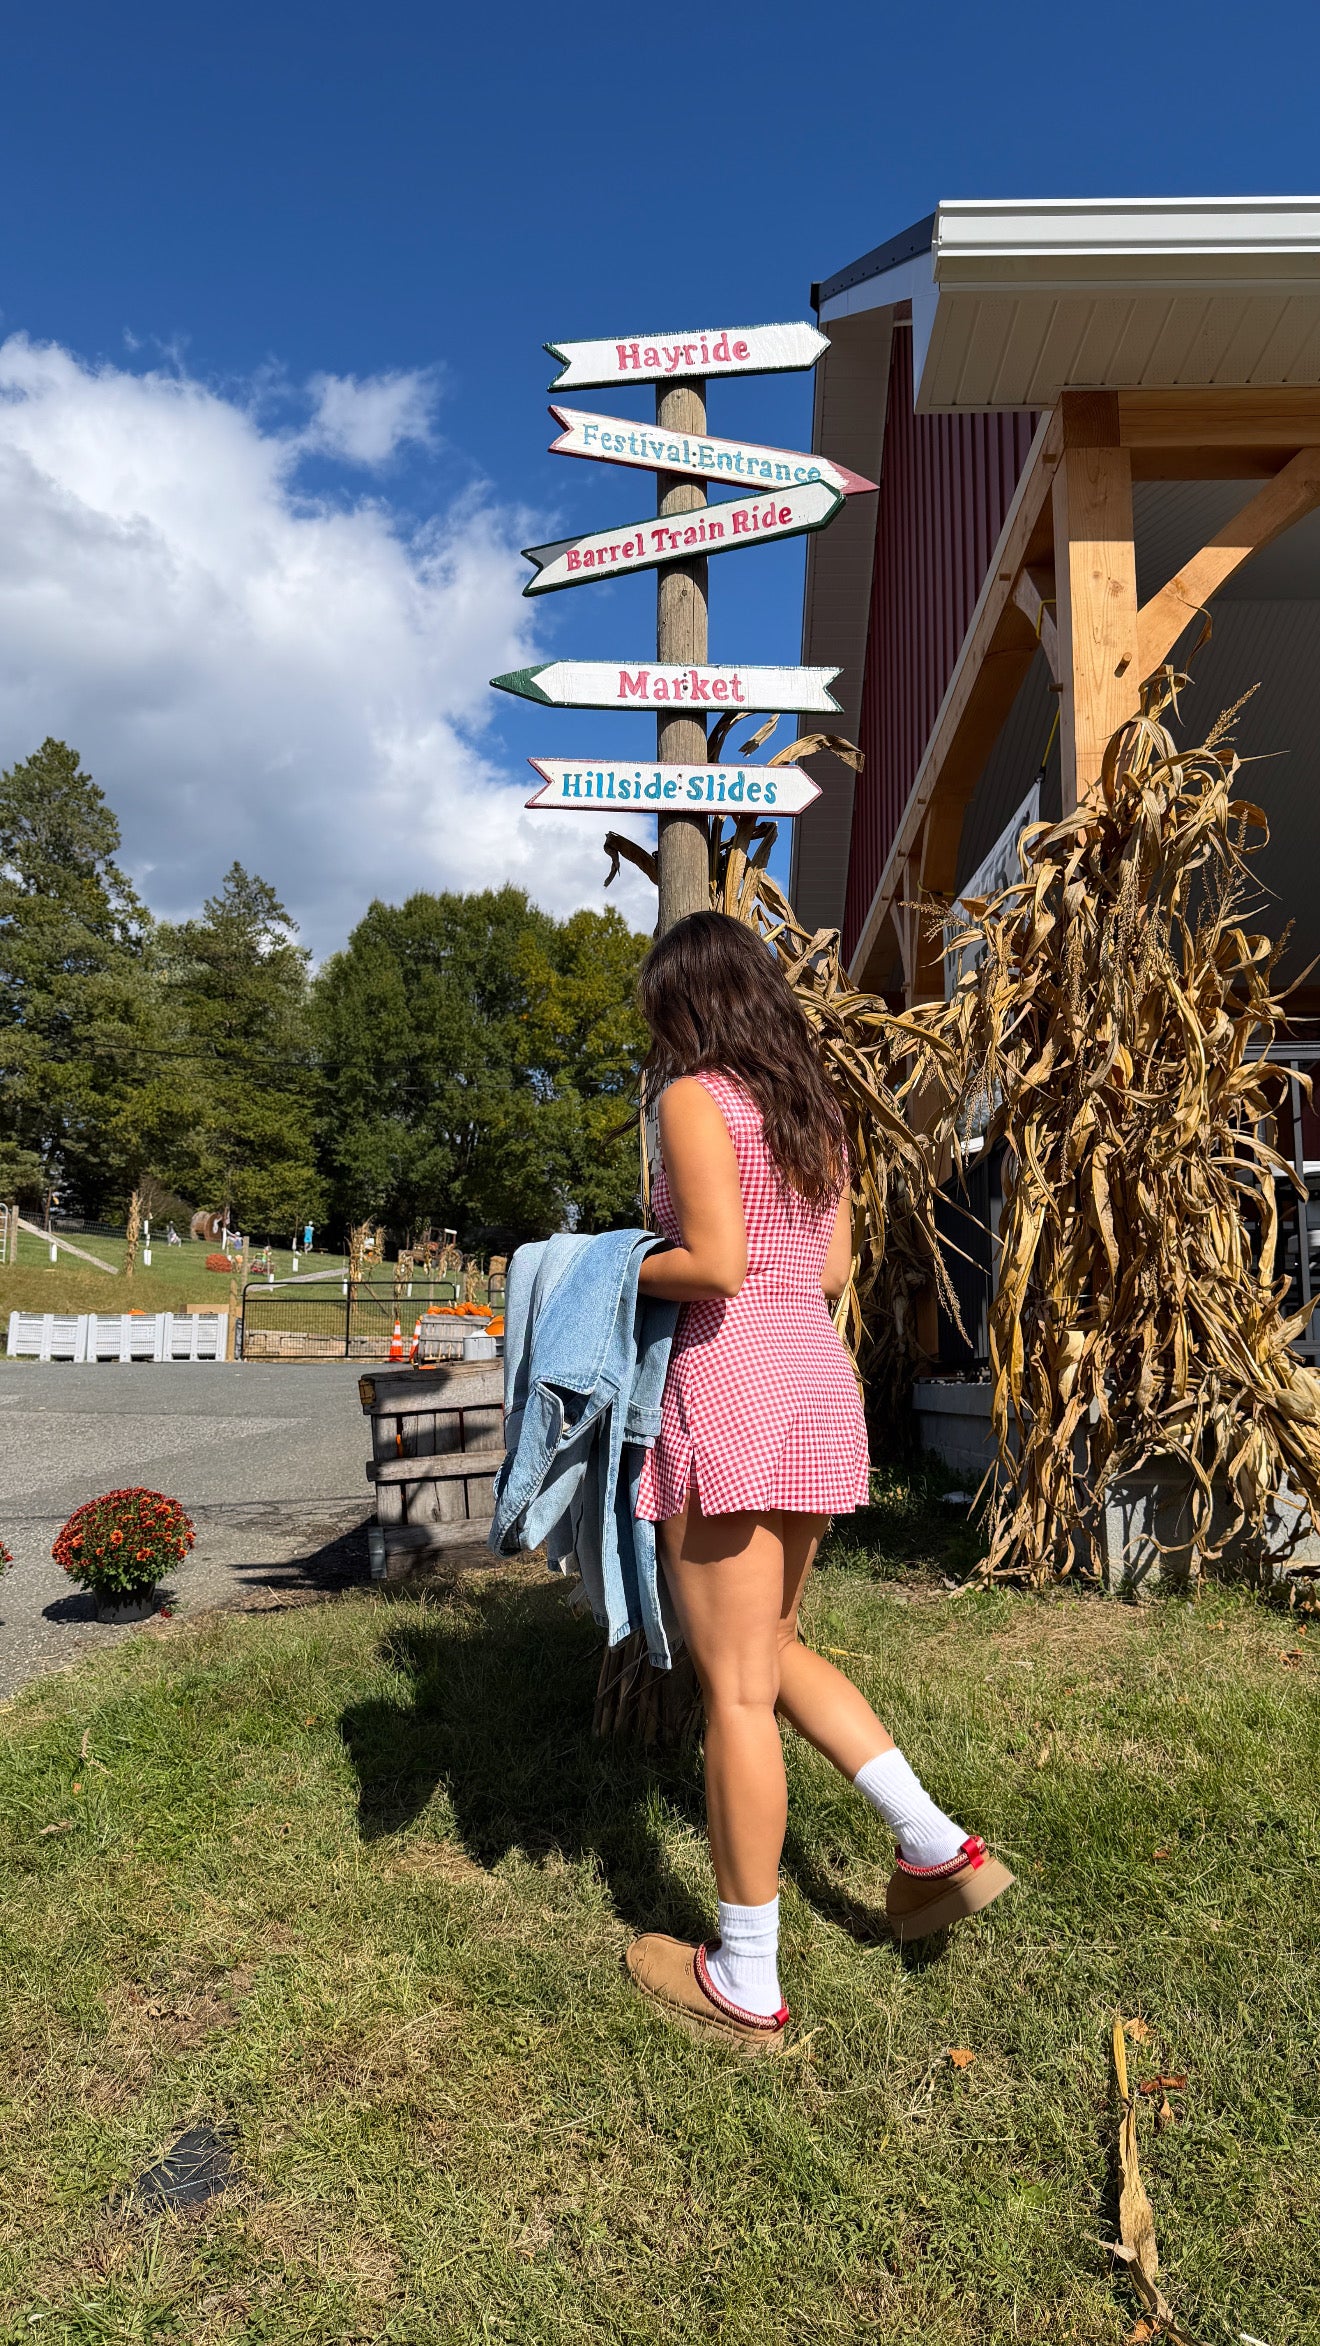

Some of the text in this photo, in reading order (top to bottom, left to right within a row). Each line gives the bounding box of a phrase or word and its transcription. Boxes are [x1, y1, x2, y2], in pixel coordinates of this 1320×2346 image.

[615, 332, 751, 372] Hayride
[582, 423, 822, 484] Festival Entrance
[565, 502, 792, 572] Barrel Train Ride
[617, 670, 745, 702] Market
[561, 771, 778, 804] Hillside Slides
